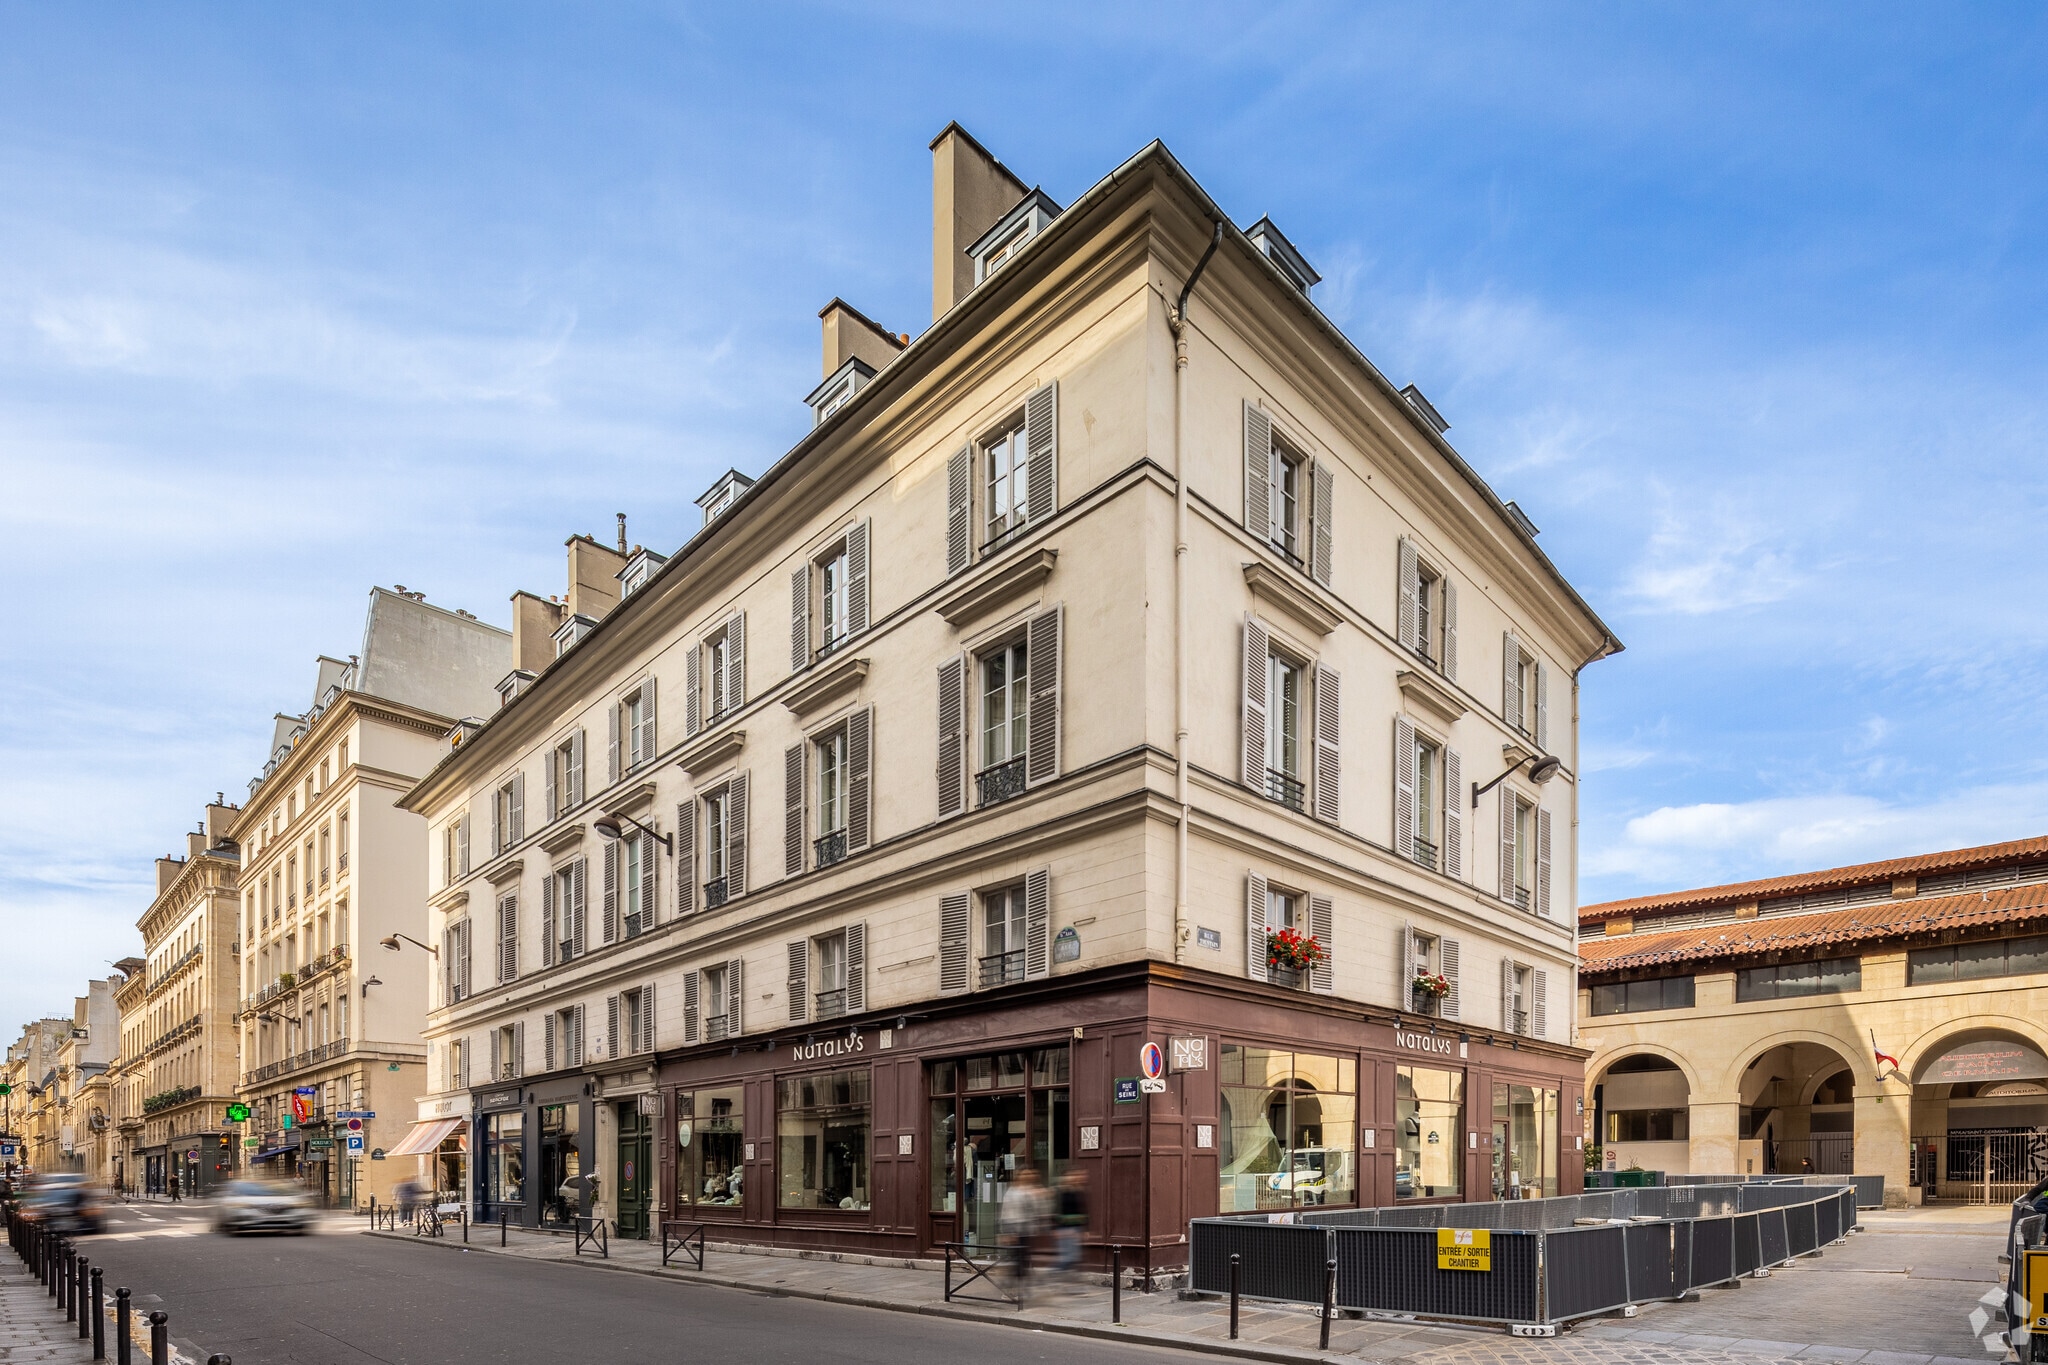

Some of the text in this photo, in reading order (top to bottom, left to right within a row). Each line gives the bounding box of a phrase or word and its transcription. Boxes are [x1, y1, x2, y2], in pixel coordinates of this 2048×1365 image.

[1939, 1051, 2024, 1062] AUDITORIUM
[1956, 1060, 2004, 1068] SAINT
[1941, 1067, 2019, 1077] GERMAIN
[1989, 1088, 2039, 1096] AUDITORIUM
[351, 1139, 359, 1147] P
[1438, 1245, 1461, 1256] ENTRÉE
[1467, 1247, 1490, 1257] SORTIE
[1448, 1258, 1480, 1268] CHANTIER
[2038, 1317, 2048, 1326] S
